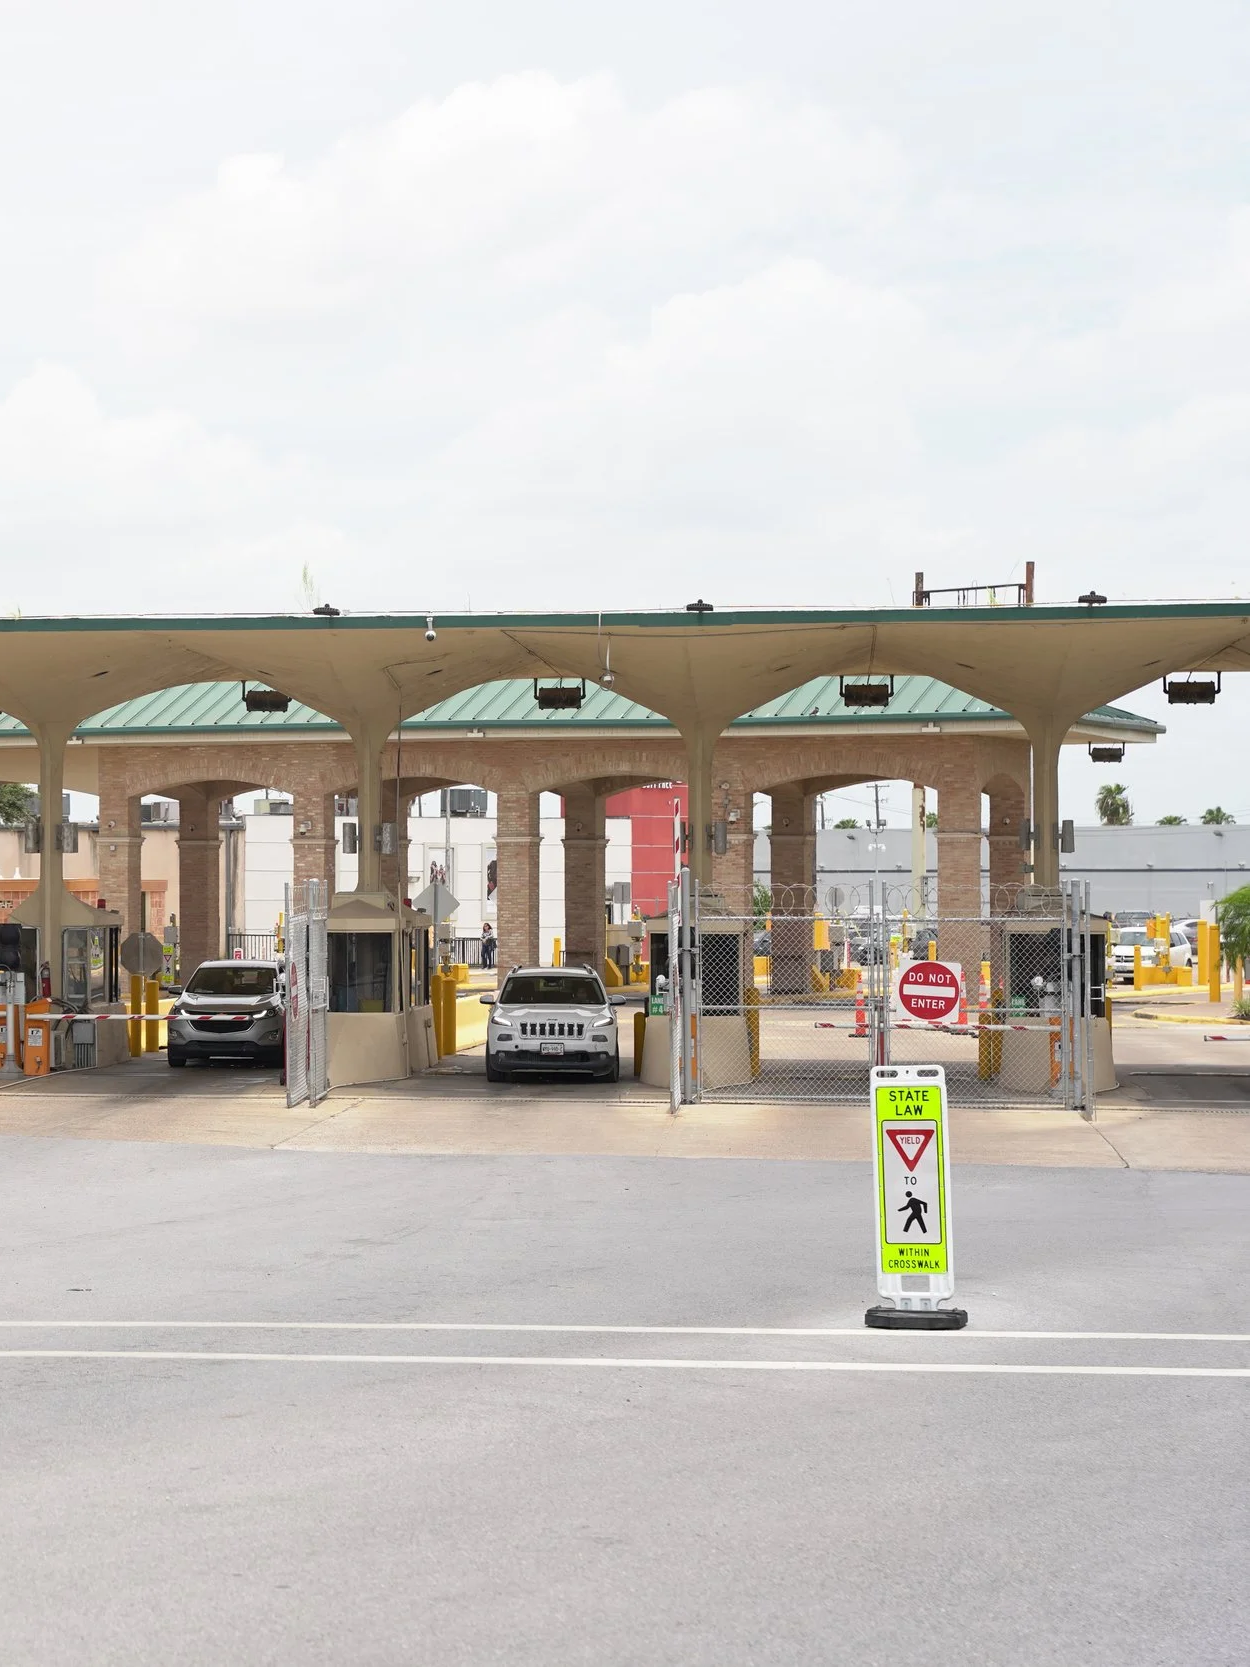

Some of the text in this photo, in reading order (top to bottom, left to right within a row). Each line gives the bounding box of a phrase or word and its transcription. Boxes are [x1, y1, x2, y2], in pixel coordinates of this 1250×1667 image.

[909, 972, 951, 984] DO NOT
[911, 998, 946, 1010] ENTER
[889, 1090, 929, 1102] STATE
[895, 1105, 923, 1116] LAW
[900, 1136, 921, 1145] YIELD
[904, 1176, 917, 1185] TO
[899, 1248, 930, 1257] WITHIN
[888, 1260, 940, 1269] CROSSWALK
